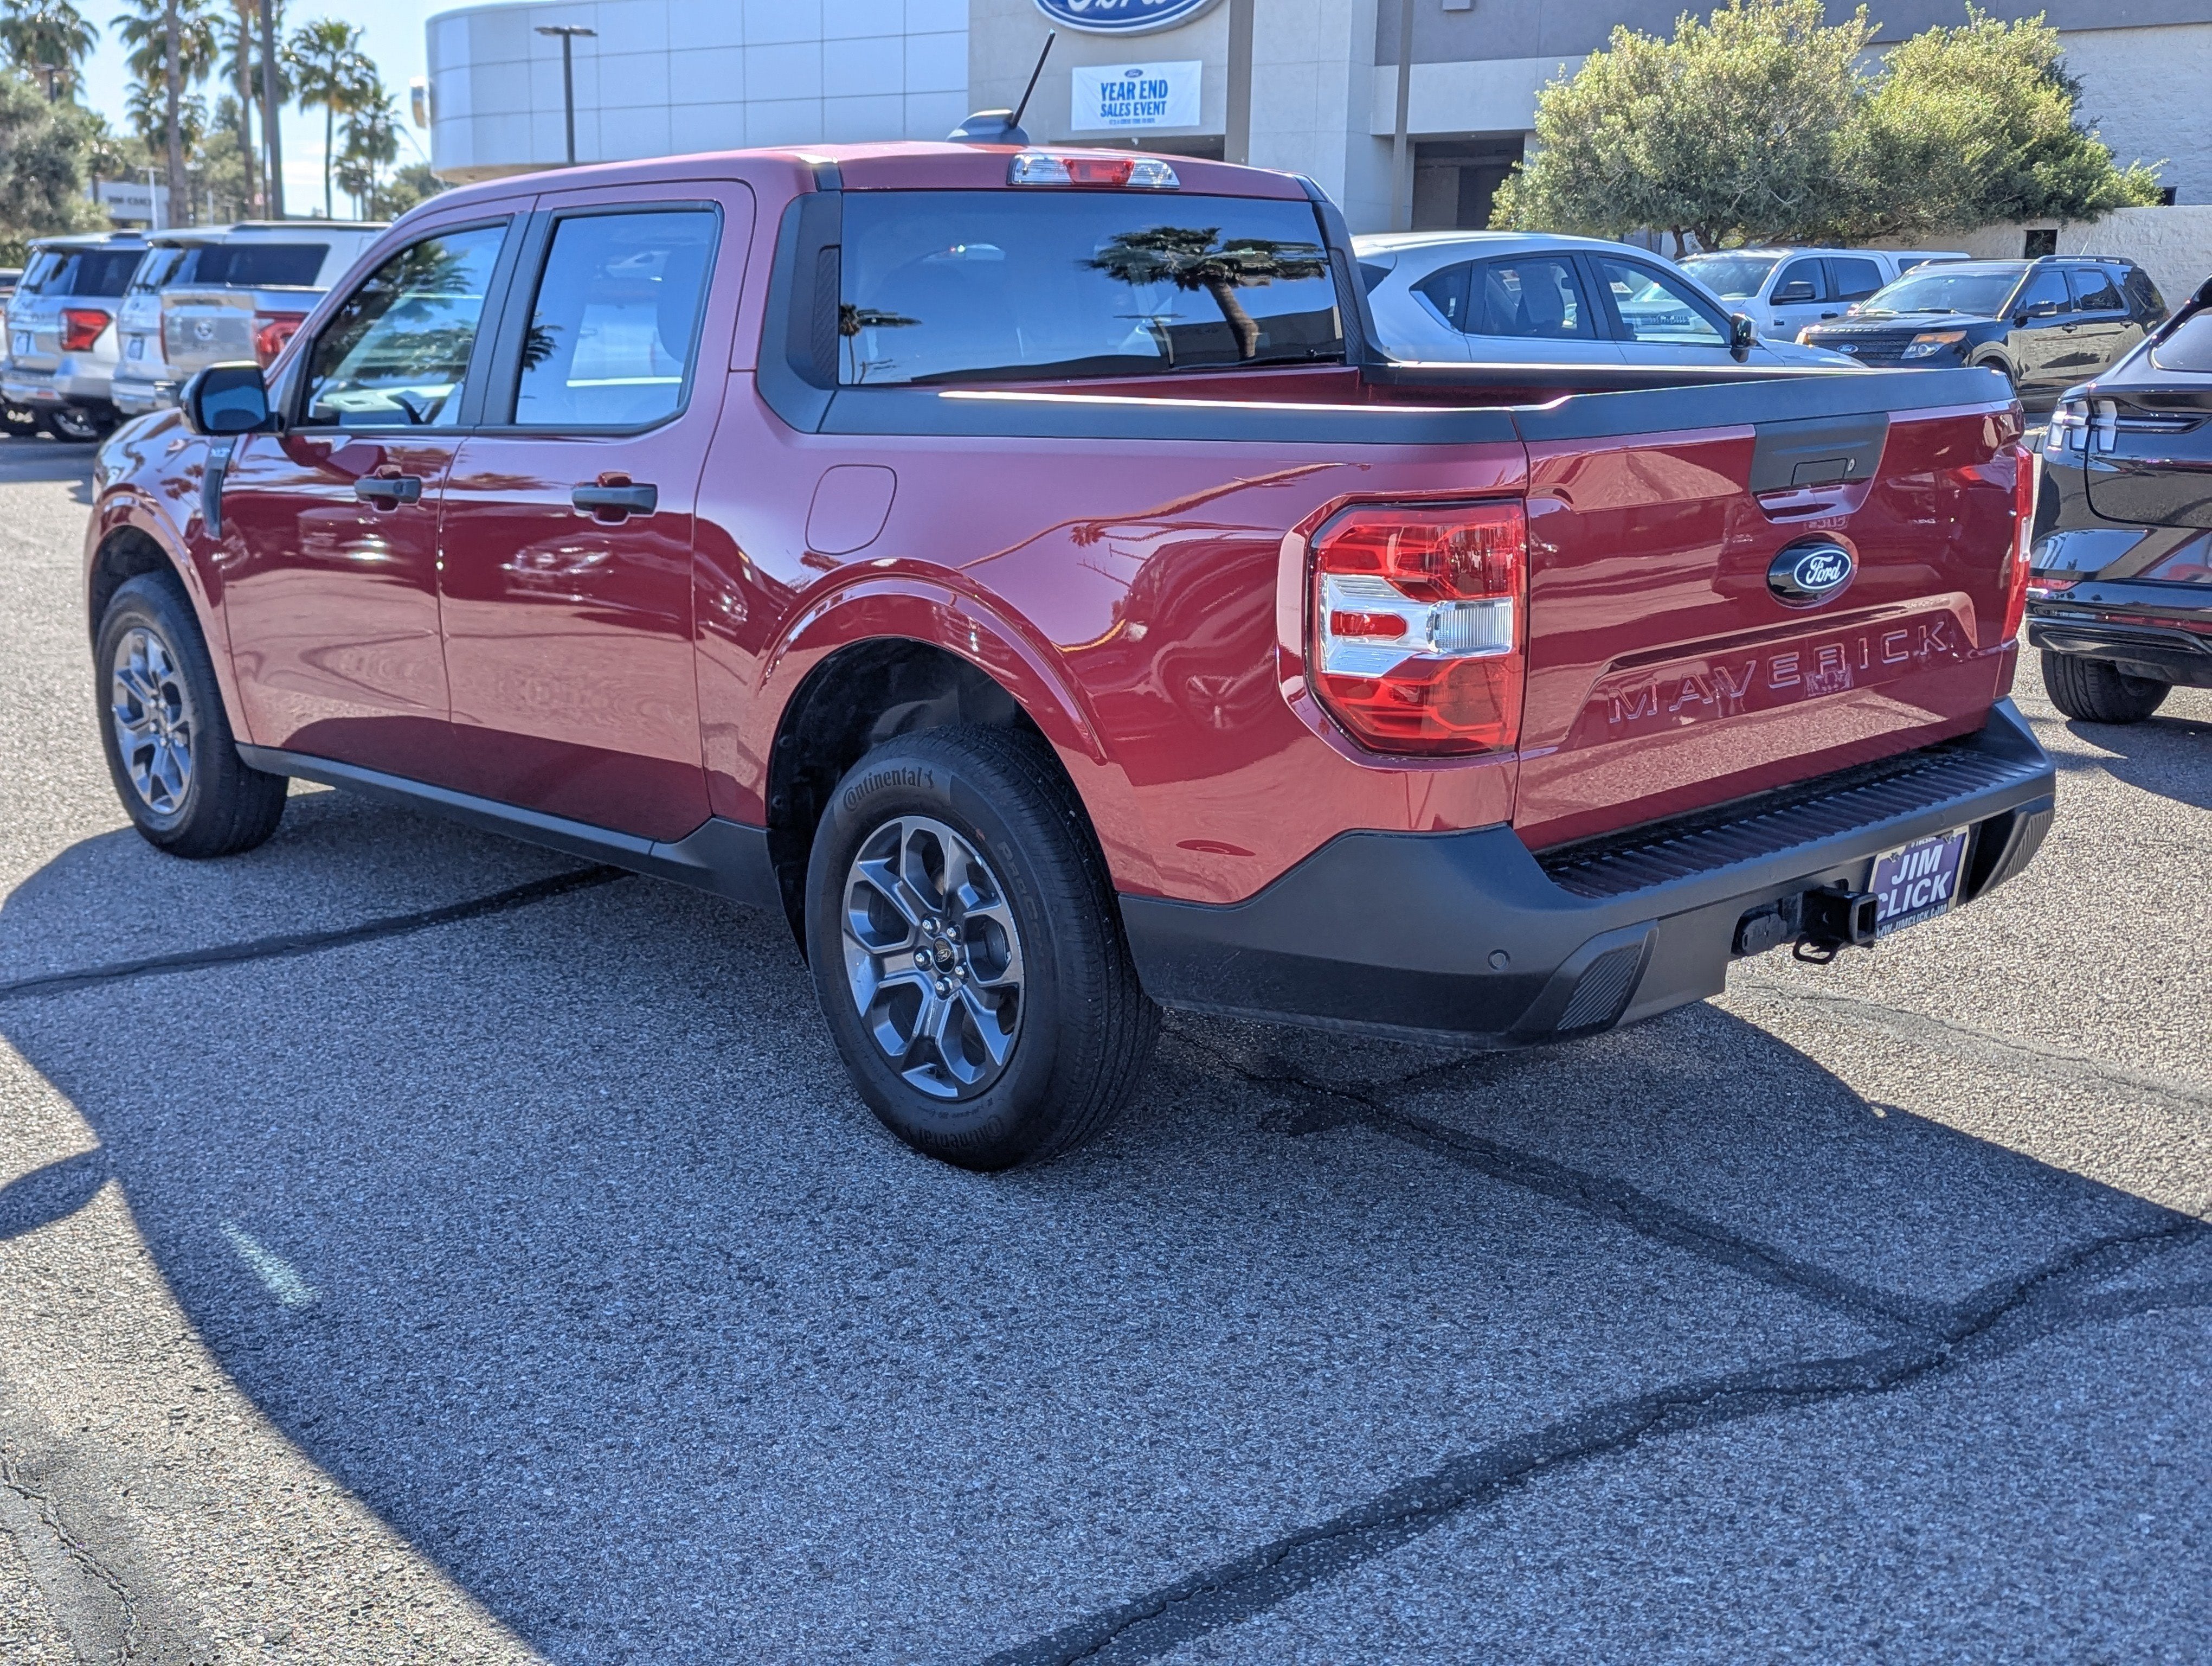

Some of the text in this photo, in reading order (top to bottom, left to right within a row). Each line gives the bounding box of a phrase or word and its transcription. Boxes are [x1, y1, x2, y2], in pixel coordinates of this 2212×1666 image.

[1100, 101, 1167, 117] SALES EVENT
[1101, 79, 1168, 101] YEAR END
[1806, 555, 1842, 584] Ford
[1609, 620, 1947, 723] MAVERICK
[843, 766, 922, 812] Continental
[1892, 844, 1944, 885] JIM
[1877, 870, 1951, 921] CLICK
